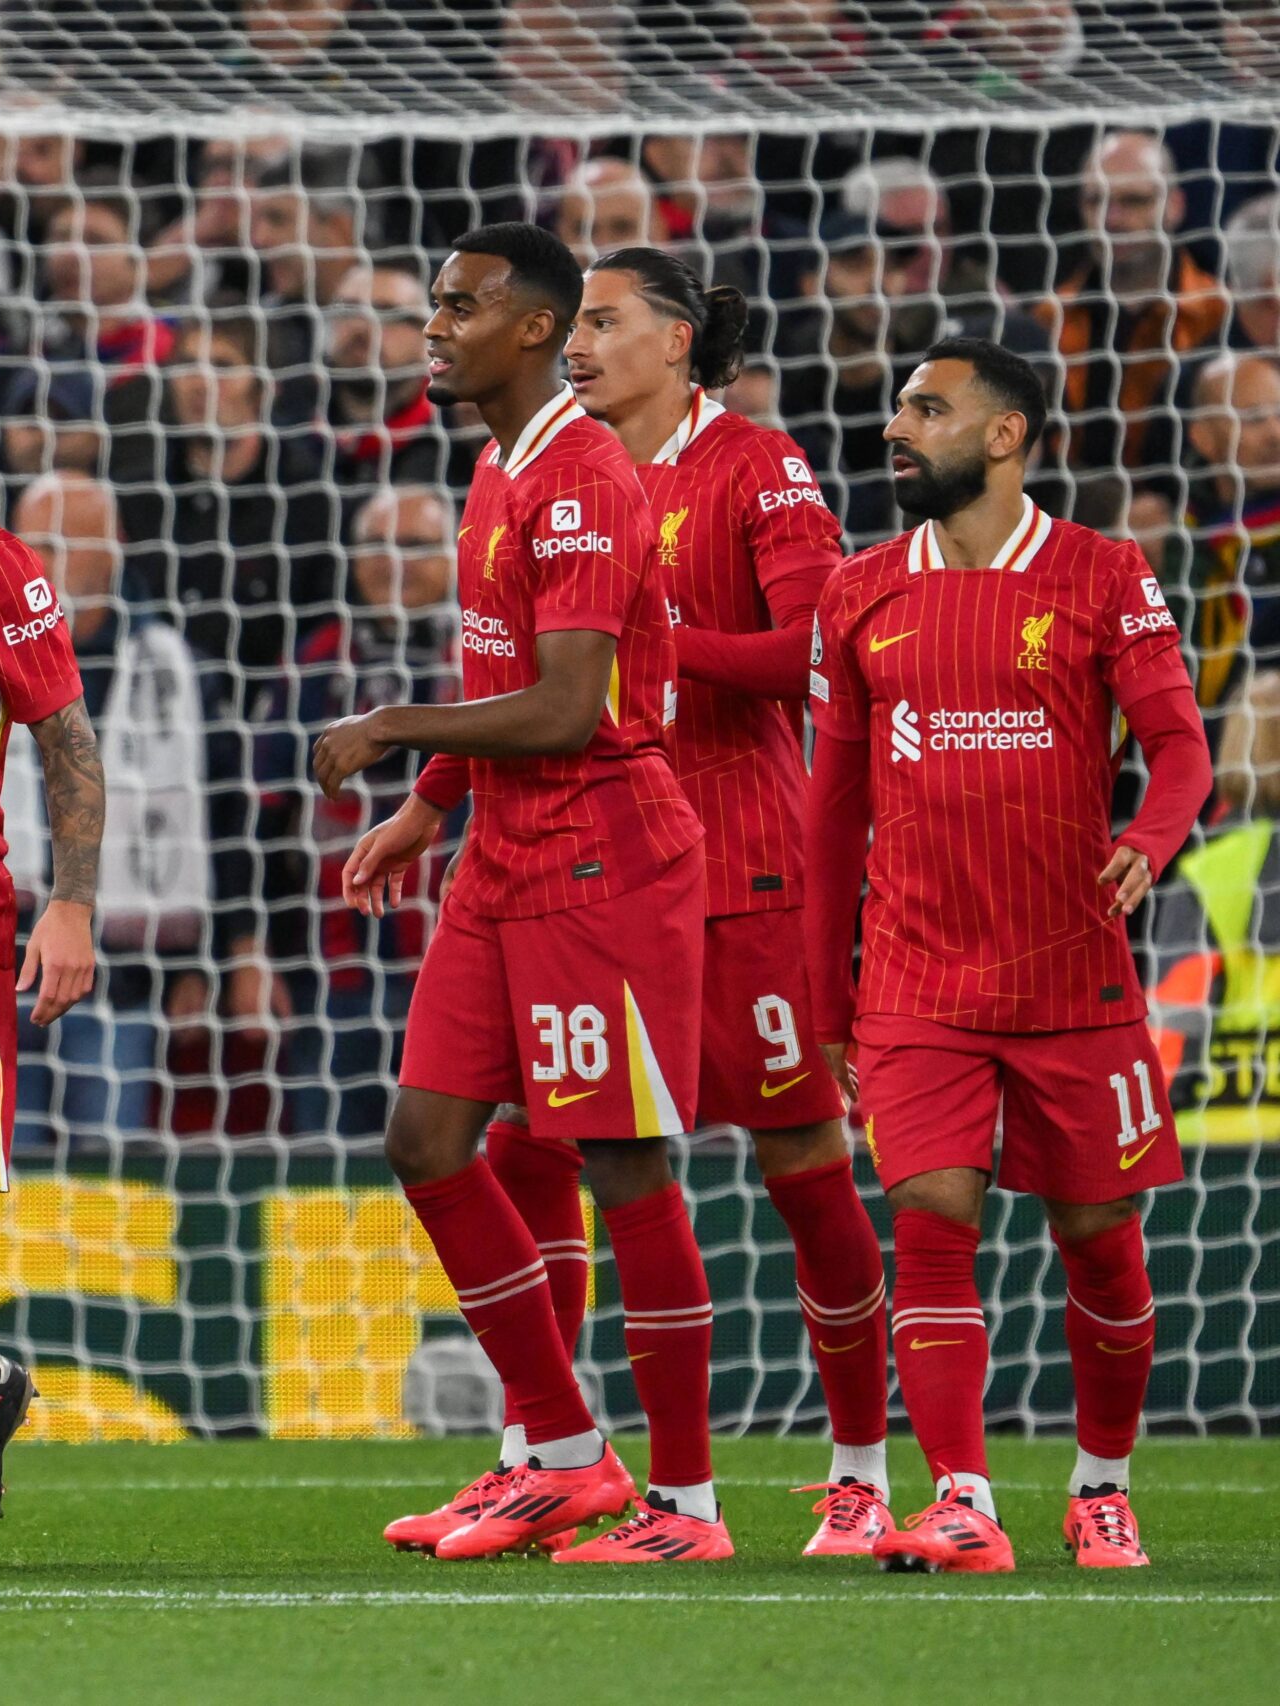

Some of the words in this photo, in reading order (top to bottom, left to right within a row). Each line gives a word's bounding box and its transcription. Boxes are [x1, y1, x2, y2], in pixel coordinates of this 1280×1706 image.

[532, 531, 612, 559] Expedia
[929, 707, 1045, 729] standard
[930, 728, 1054, 751] chartered
[531, 1004, 611, 1081] 38
[753, 994, 802, 1073] 9
[1109, 1060, 1163, 1147] 11
